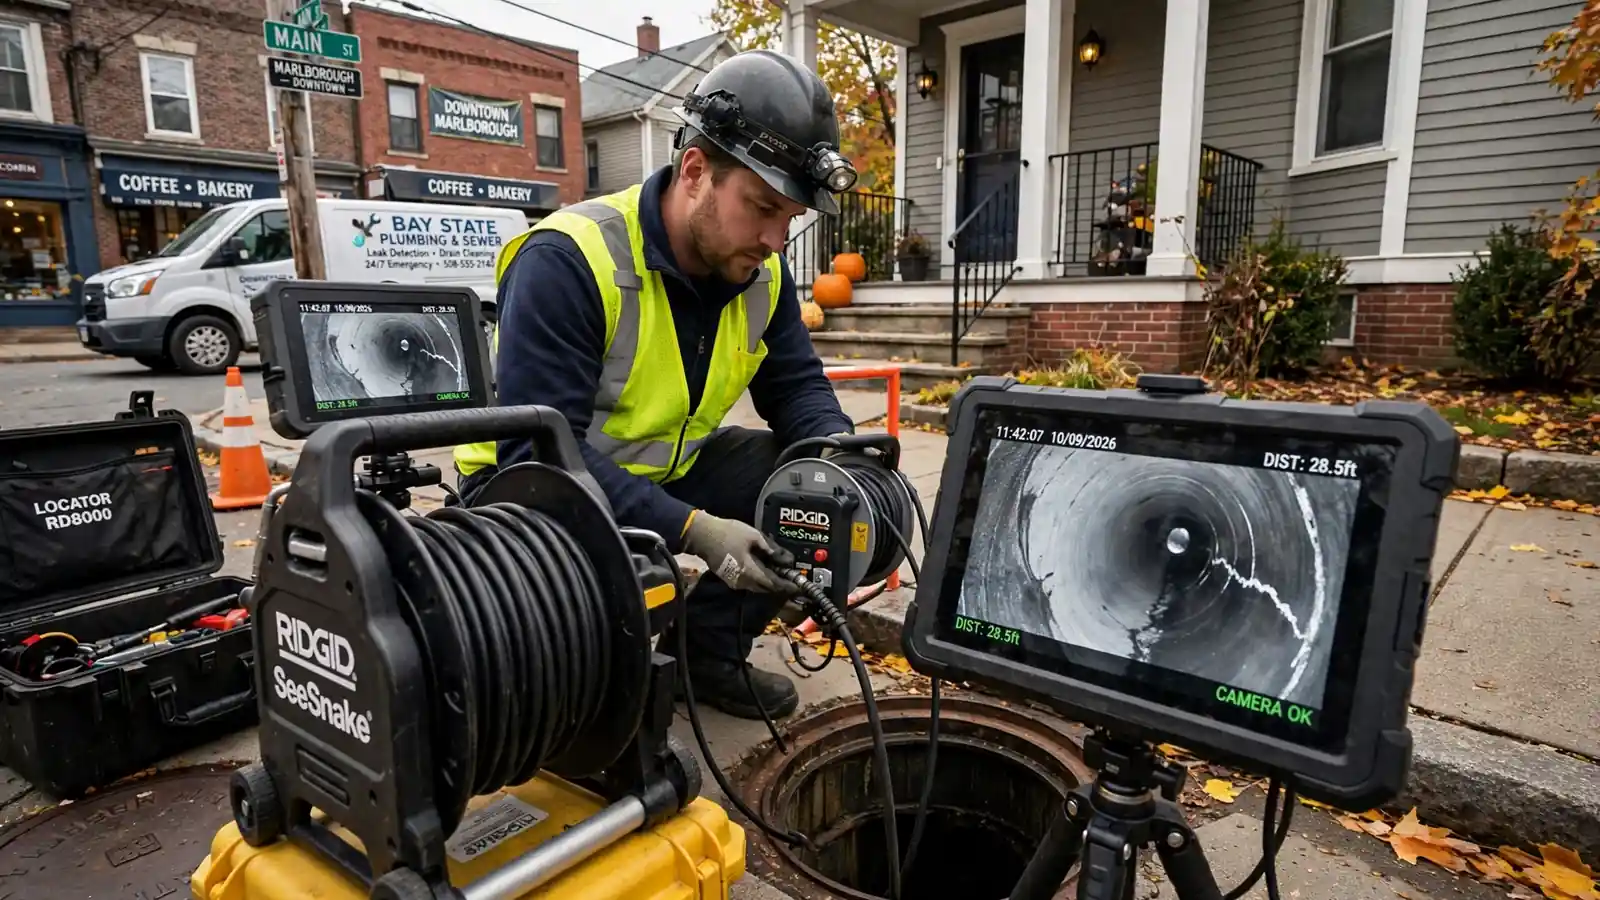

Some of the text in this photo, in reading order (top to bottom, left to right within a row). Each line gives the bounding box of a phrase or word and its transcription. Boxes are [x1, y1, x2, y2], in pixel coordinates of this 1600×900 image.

[274, 26, 353, 56] MAIN ST
[274, 61, 355, 84] MARLBOROUGH
[293, 77, 346, 94] DOWNTOWN
[444, 99, 509, 122] DOWNTOWN
[435, 113, 518, 138] MARLBOROUGH
[119, 174, 254, 198] COFFEE BAKERY
[428, 179, 532, 201] COFFEE BAKERY
[392, 216, 497, 235] BAY STATE
[380, 233, 502, 247] PLUMBING & SEWER
[366, 248, 387, 257] Leak
[390, 248, 430, 258] Detection
[439, 249, 461, 258] Drain
[365, 260, 385, 269] 24/7
[388, 259, 434, 271] Emergency
[996, 426, 1117, 450] 11:42:07 10/09/2026
[1263, 452, 1358, 477] DIST: 28.5ft
[33, 492, 112, 515] LOCATOR
[45, 508, 112, 530] RD8000
[780, 507, 830, 526] RIDGID
[955, 617, 1020, 645] DIST: 28.5ft
[1216, 686, 1314, 726] CAMERA OK
